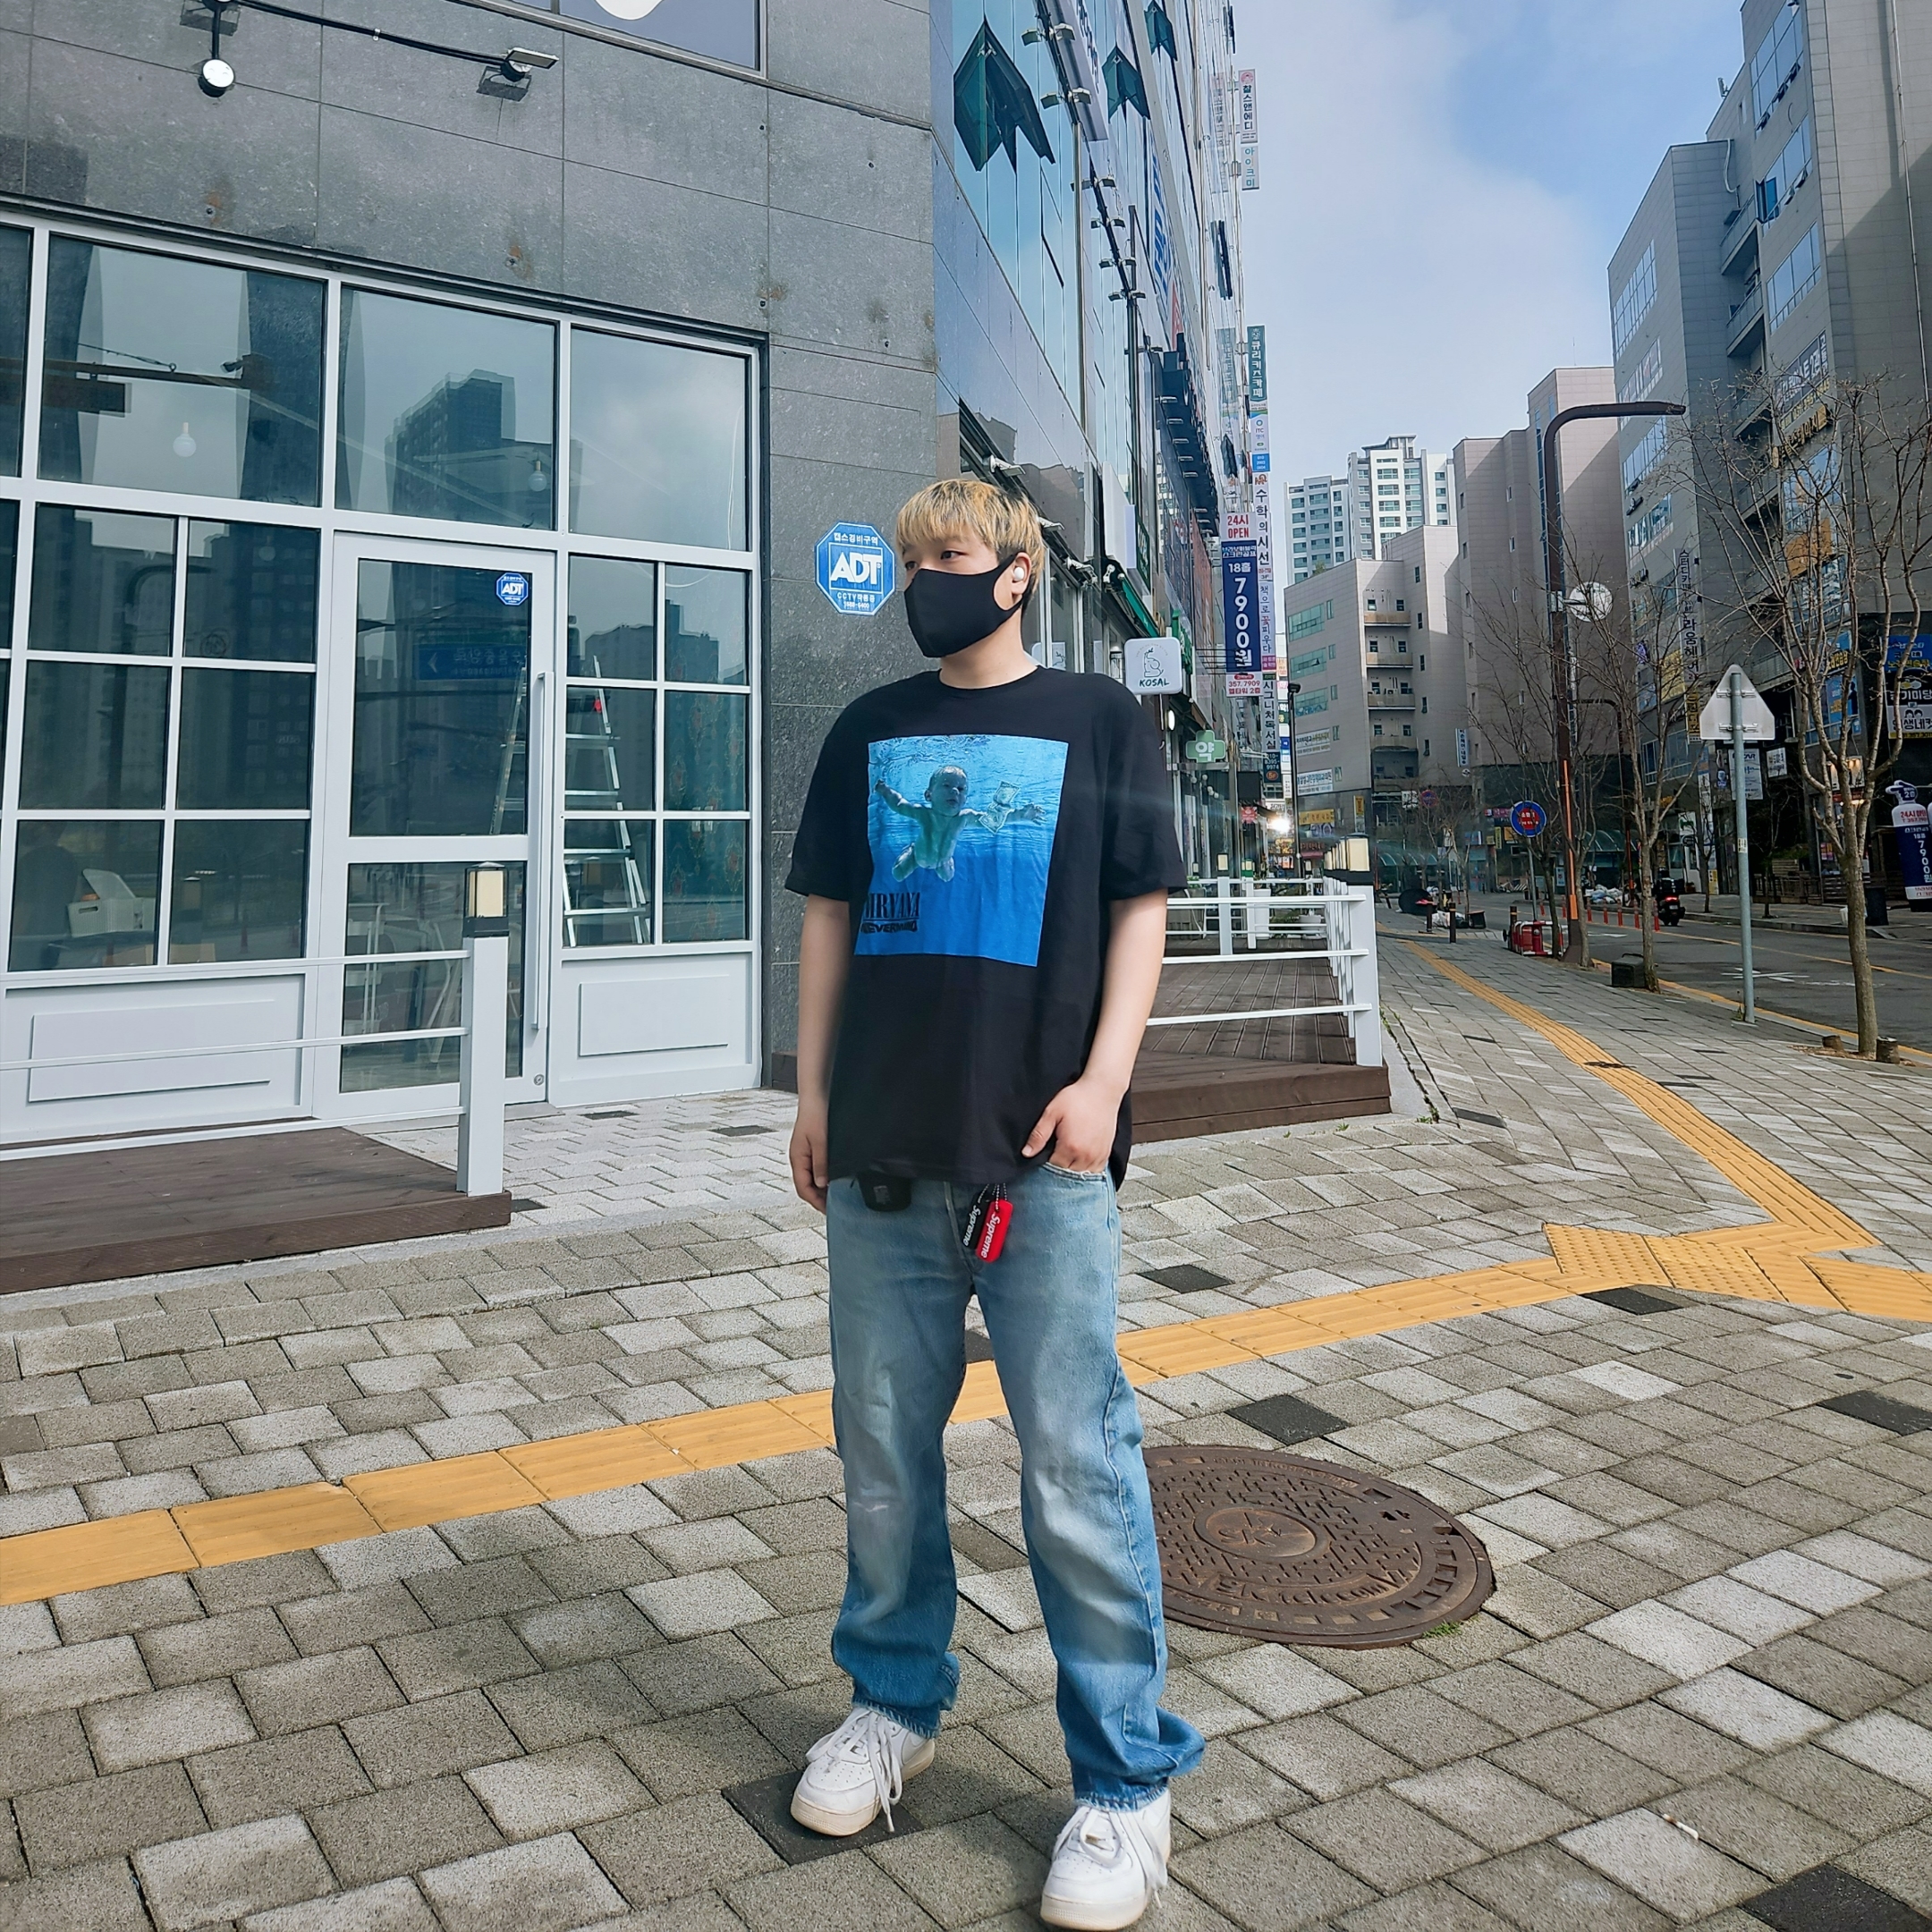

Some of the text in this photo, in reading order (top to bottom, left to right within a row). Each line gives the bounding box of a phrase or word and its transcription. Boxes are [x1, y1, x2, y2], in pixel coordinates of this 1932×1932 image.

[1227, 513, 1249, 526] 24시
[1255, 489, 1270, 565] 수학의시선
[1228, 528, 1250, 538] OPEN
[830, 552, 882, 585] ADT
[502, 582, 523, 595] ADT
[1139, 677, 1170, 688] KOSAL
[1263, 681, 1275, 750] 시그니처독서실
[1195, 741, 1215, 761] 약
[962, 1205, 981, 1247] Supreme
[980, 1212, 1001, 1258] Supreme
